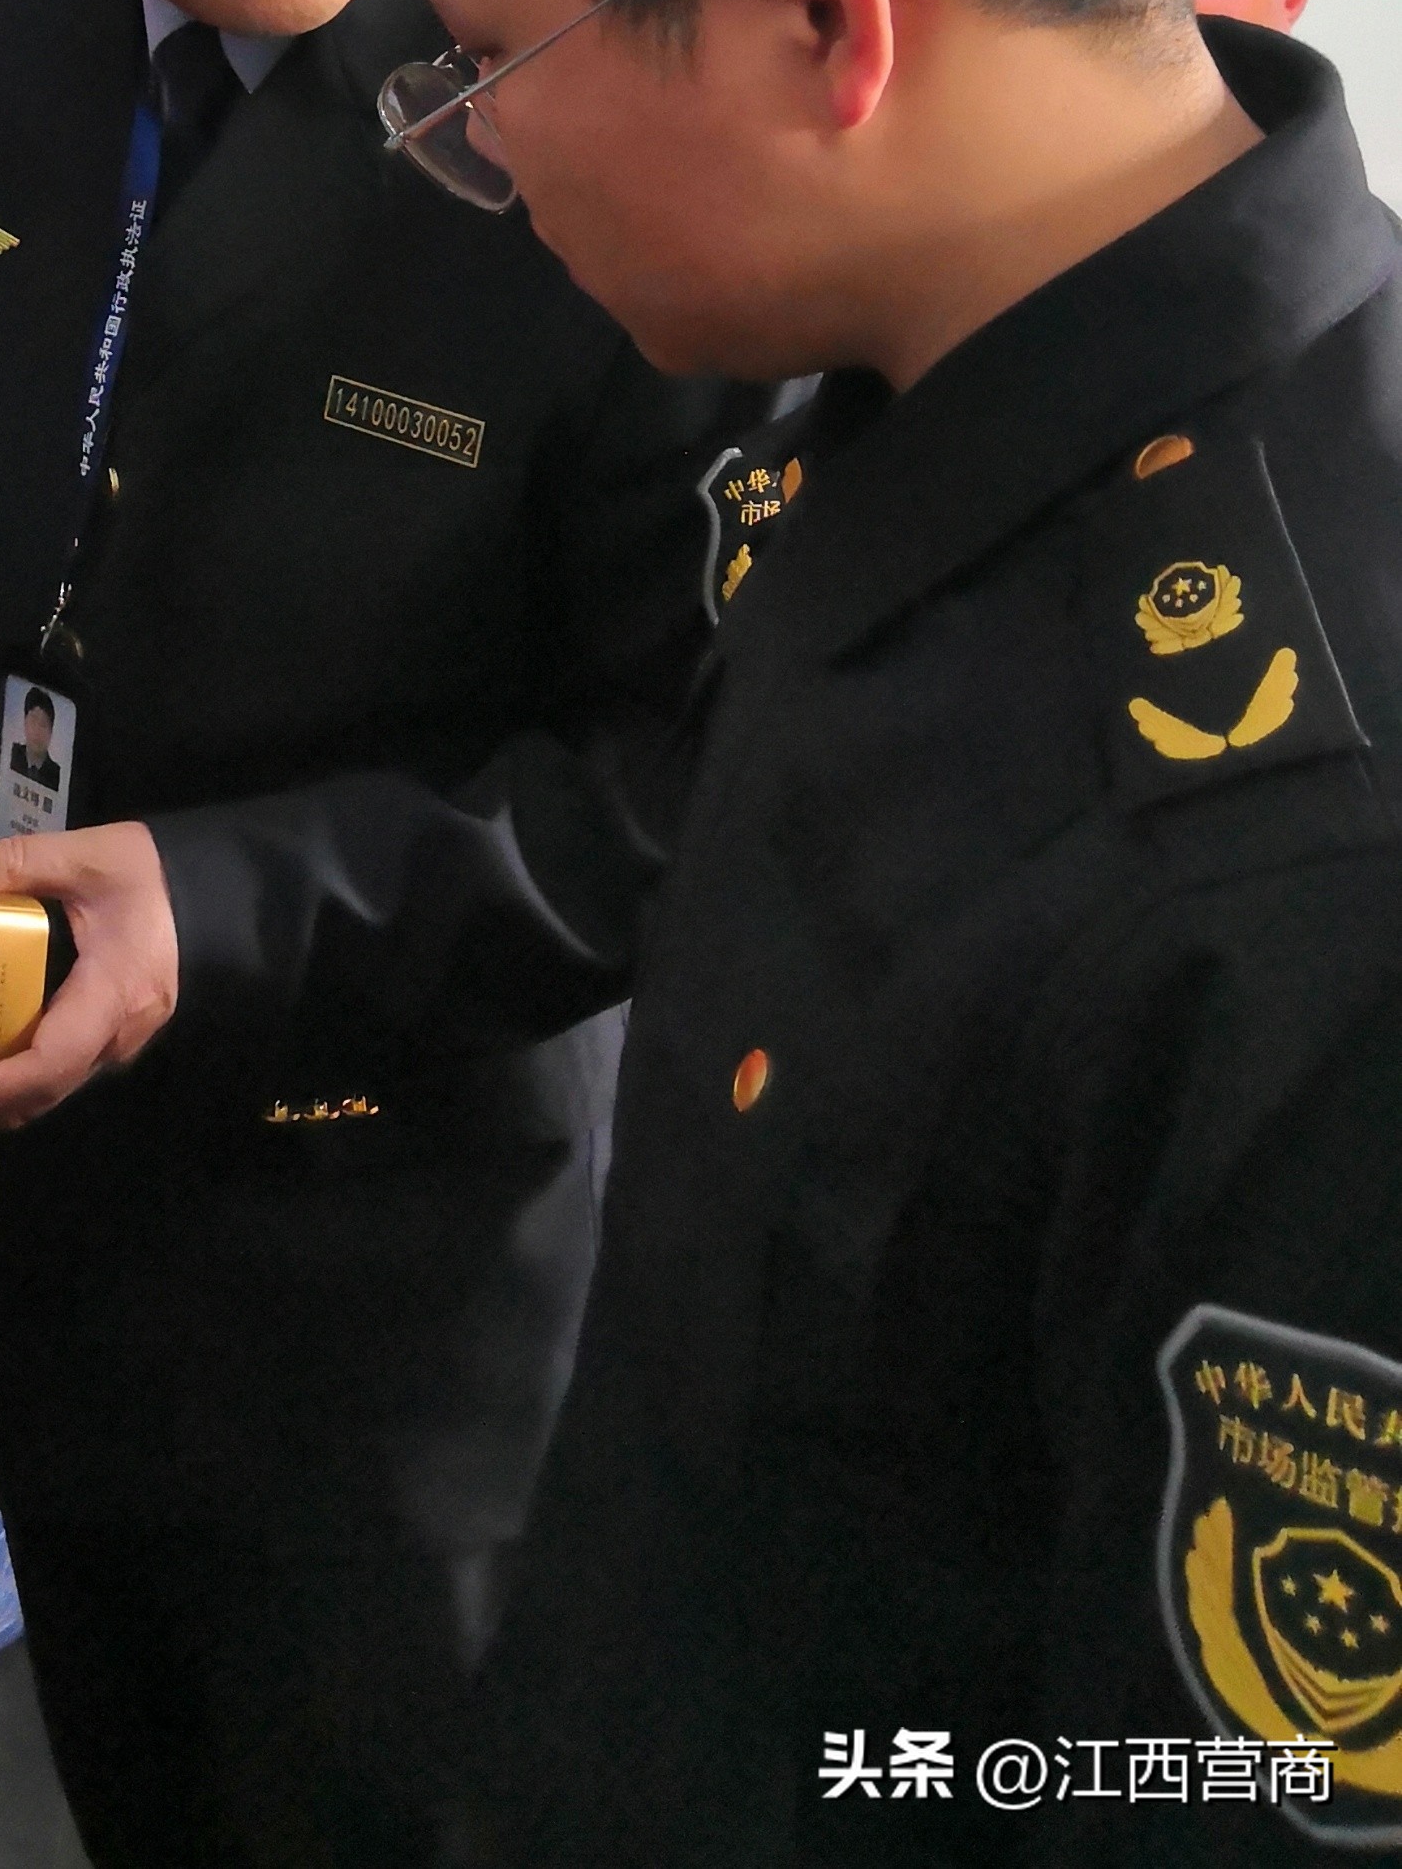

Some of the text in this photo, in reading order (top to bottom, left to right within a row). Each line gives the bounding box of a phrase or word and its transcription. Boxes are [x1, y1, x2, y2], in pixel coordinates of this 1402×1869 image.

[79, 199, 148, 476] 中华人民共和国行政执法证
[335, 387, 478, 457] 14100030052
[1218, 1413, 1402, 1534] 市场监管
